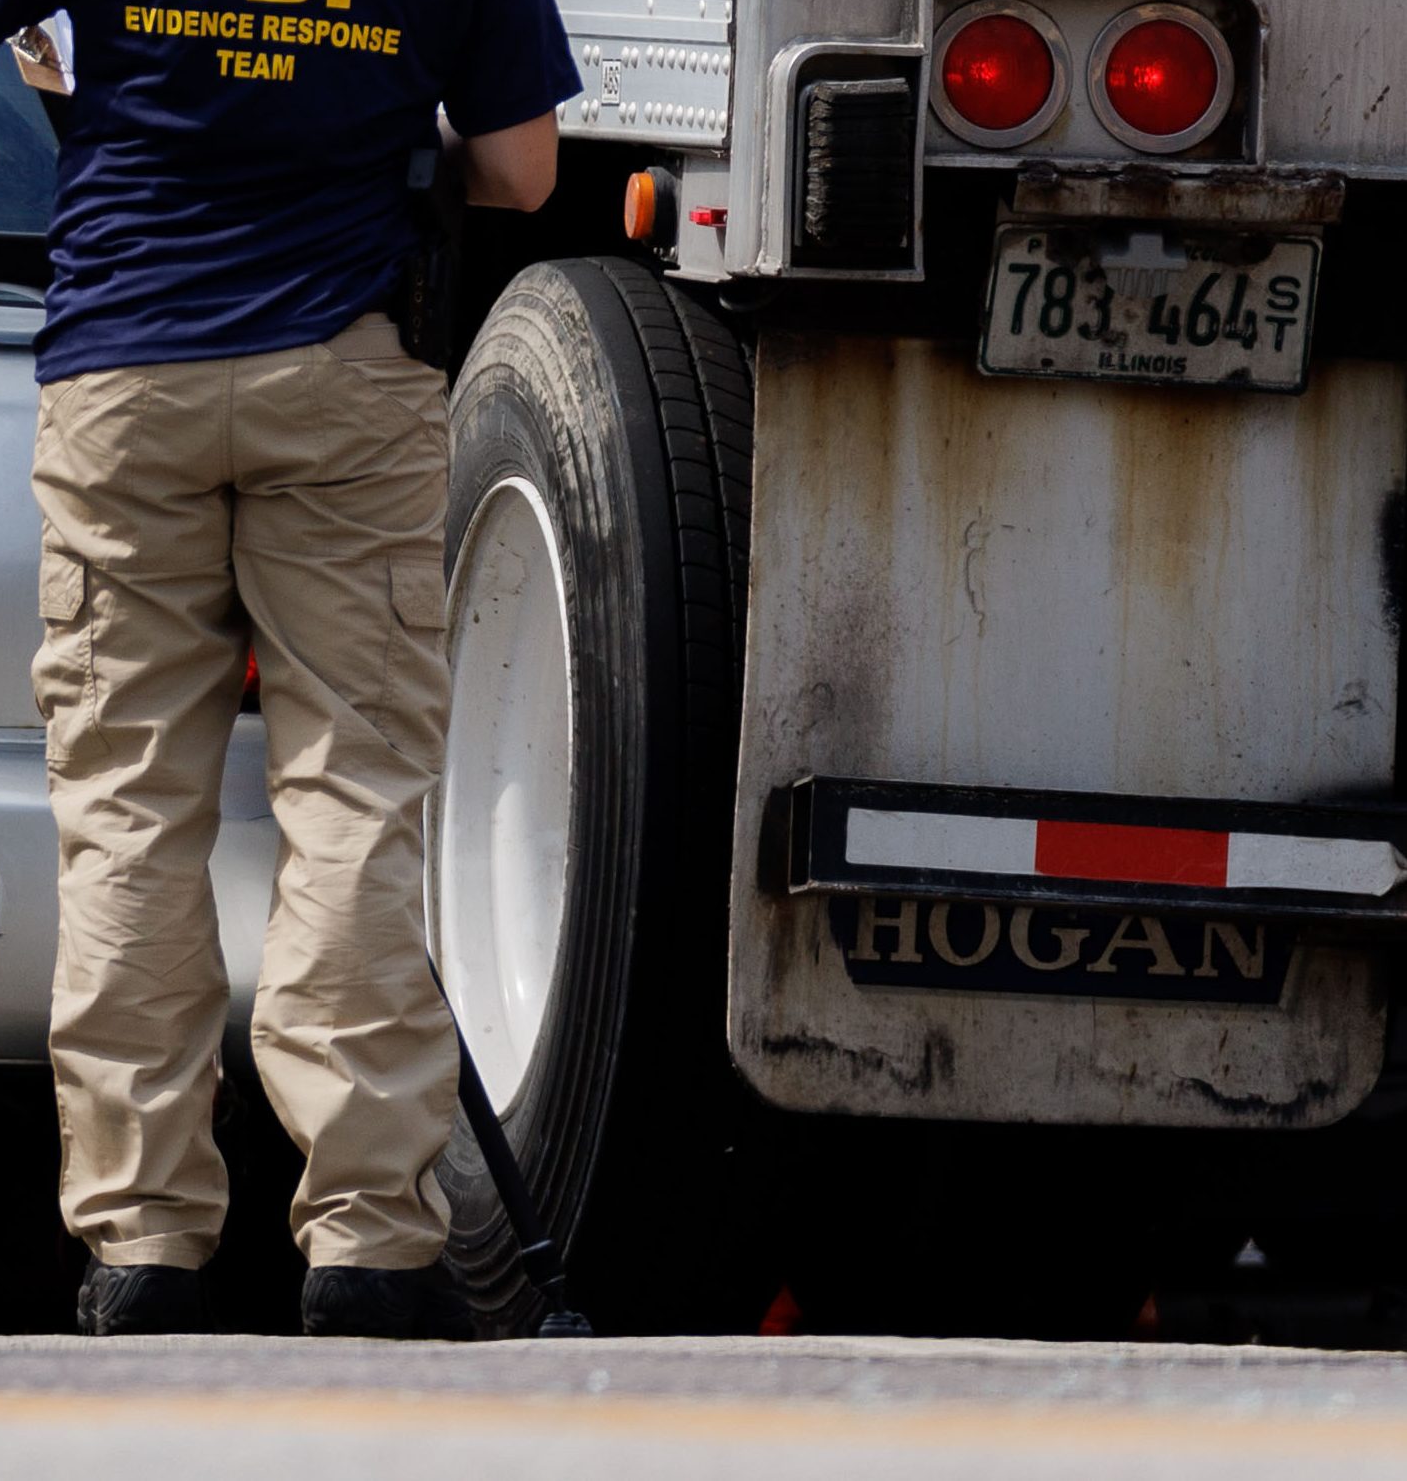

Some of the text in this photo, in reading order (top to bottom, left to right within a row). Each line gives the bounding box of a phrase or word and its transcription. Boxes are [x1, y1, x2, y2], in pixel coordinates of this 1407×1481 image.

[125, 6, 402, 55] EVIDENCE RESPONSE
[216, 48, 295, 82] TEAM
[1098, 351, 1186, 375] ILLINOIS
[847, 898, 1266, 980] HOGAN
